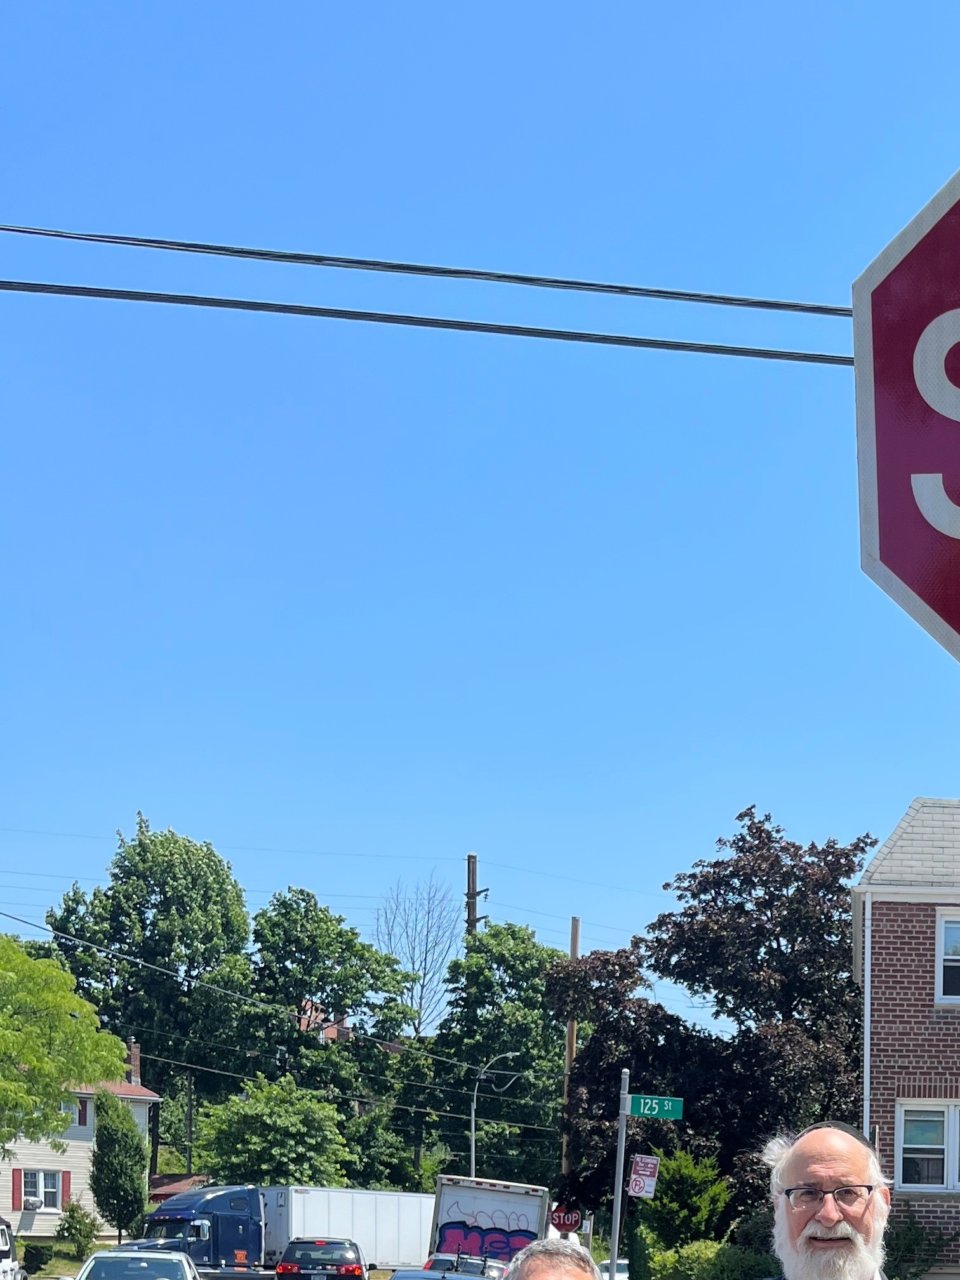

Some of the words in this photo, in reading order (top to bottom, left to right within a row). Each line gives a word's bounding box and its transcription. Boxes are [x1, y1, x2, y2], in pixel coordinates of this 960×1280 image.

[639, 1098, 659, 1115] 125
[663, 1101, 672, 1111] St
[552, 1212, 579, 1225] STOP
